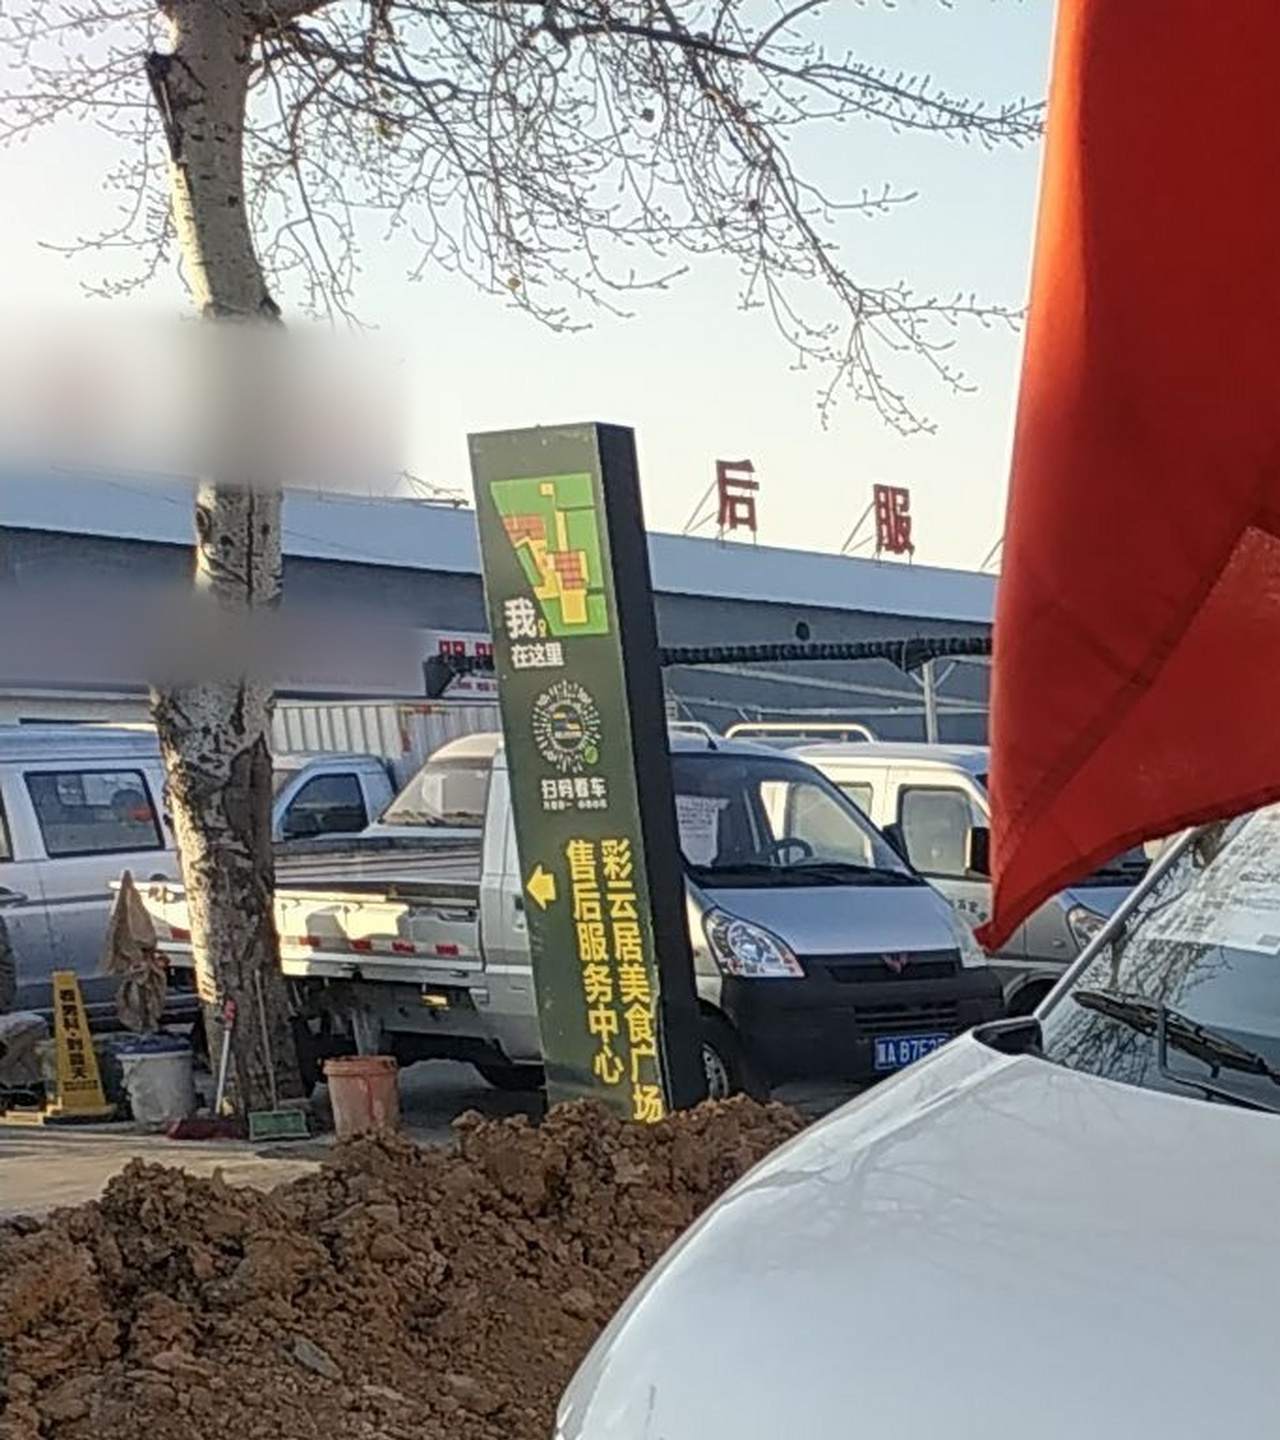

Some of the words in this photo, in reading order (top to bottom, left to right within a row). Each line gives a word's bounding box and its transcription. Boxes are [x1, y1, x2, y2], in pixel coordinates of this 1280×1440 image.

[716, 459, 759, 531] 后
[873, 484, 914, 554] 服
[504, 597, 537, 639] 我
[511, 642, 564, 669] 在这里
[541, 776, 606, 799] 扫码看车
[566, 839, 625, 1085] 售后服务中心
[601, 838, 664, 1123] 彩云居美食广场
